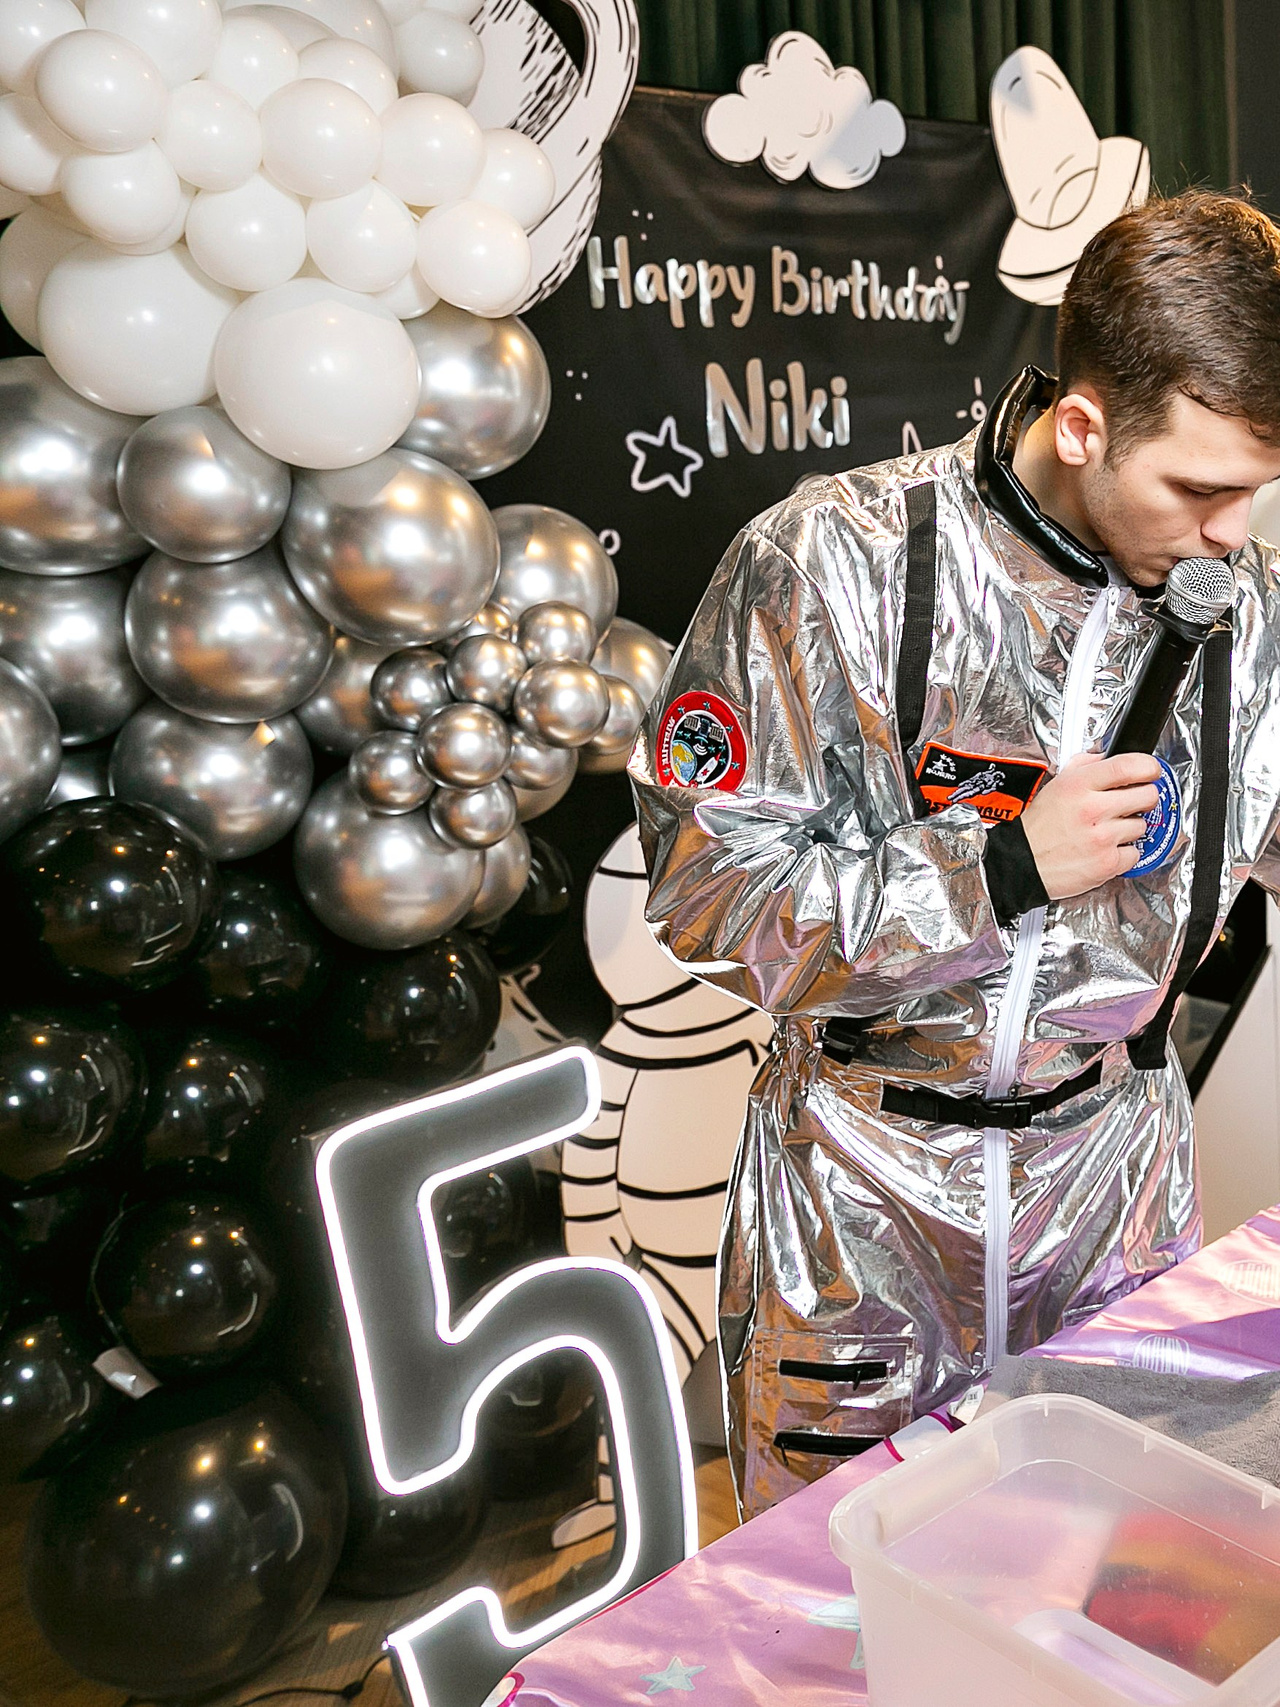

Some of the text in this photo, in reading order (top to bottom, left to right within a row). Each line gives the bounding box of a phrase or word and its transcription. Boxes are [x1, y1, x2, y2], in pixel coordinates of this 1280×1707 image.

[587, 235, 967, 345] Happy Birthday
[705, 358, 851, 458] Niki
